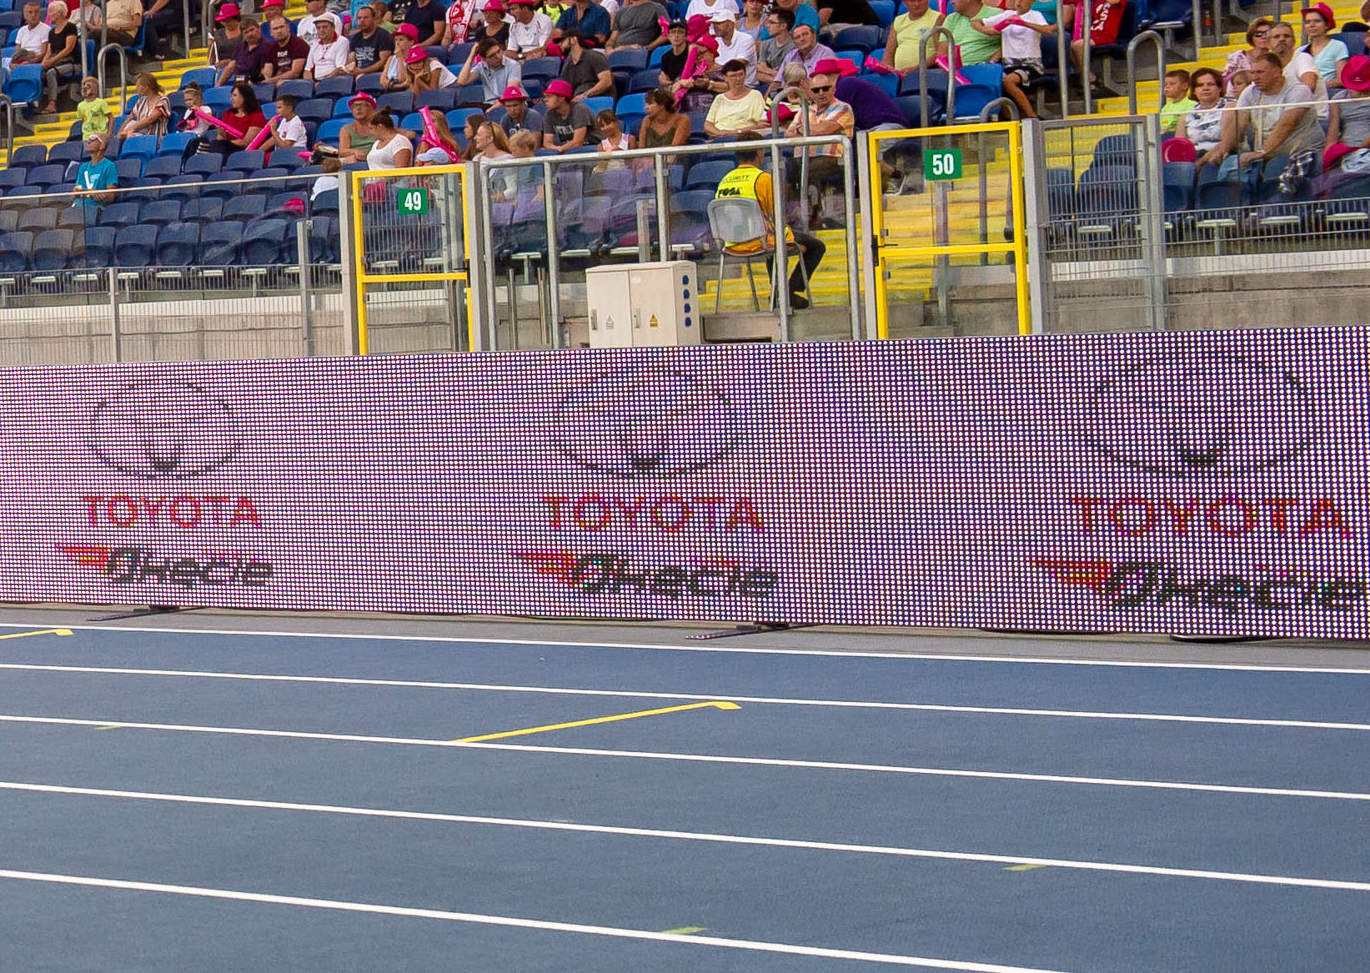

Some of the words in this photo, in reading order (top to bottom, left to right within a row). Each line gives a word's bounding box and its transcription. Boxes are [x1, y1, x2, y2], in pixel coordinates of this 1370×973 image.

[932, 153, 954, 175] 50
[404, 191, 422, 210] 49
[82, 492, 261, 528] TOYOTA
[543, 493, 764, 533] TOYOTA
[1071, 497, 1355, 539] TOYOTA
